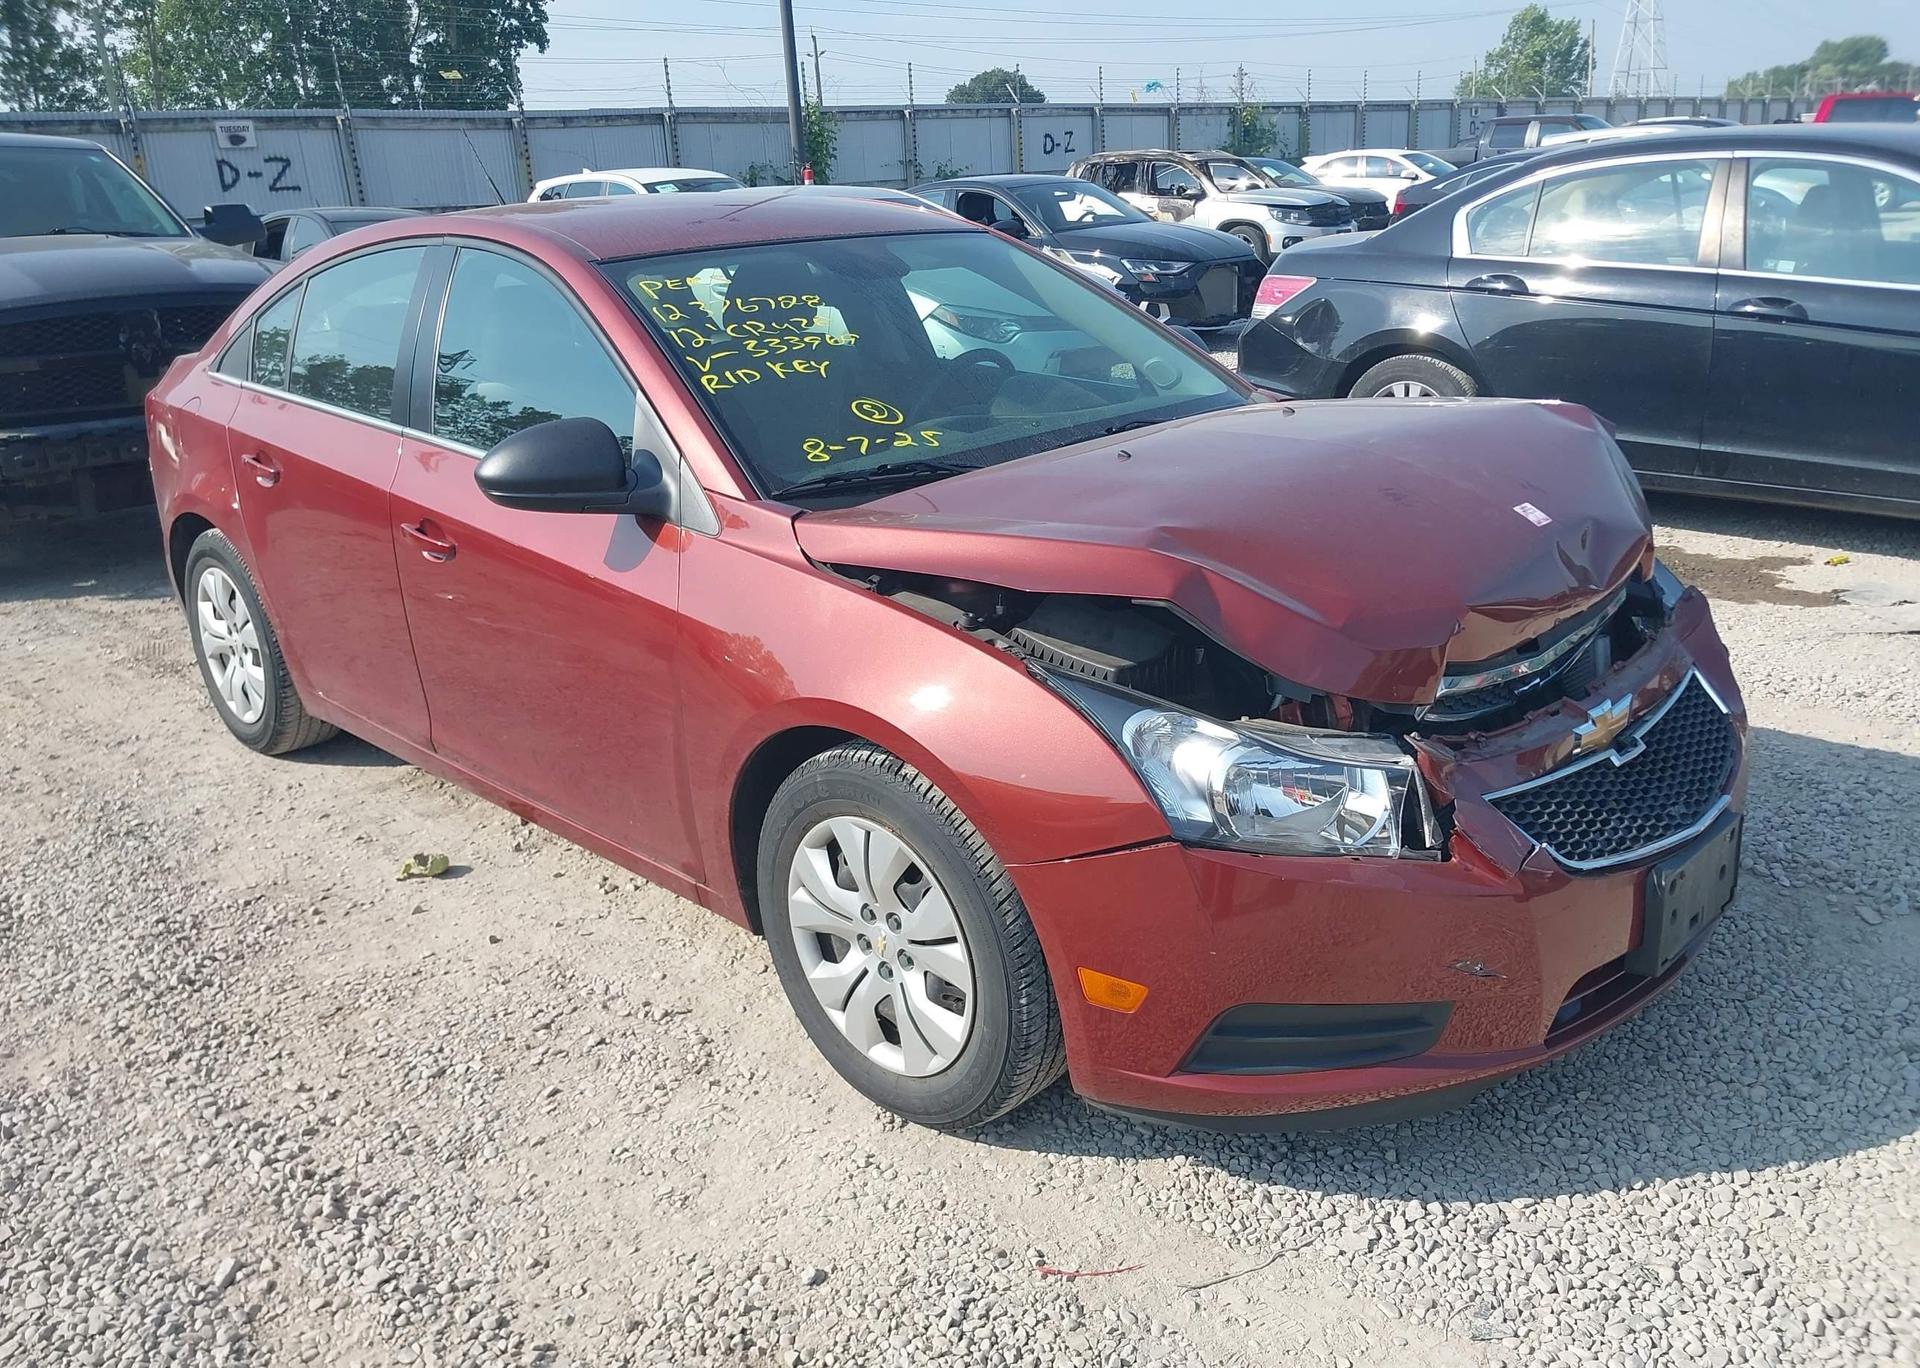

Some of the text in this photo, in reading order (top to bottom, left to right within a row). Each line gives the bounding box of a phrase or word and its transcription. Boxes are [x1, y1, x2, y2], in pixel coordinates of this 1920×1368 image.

[219, 125, 249, 133] TUESDAY
[1043, 131, 1075, 154] D-Z
[216, 156, 301, 192] D-Z
[766, 359, 830, 379] KEY
